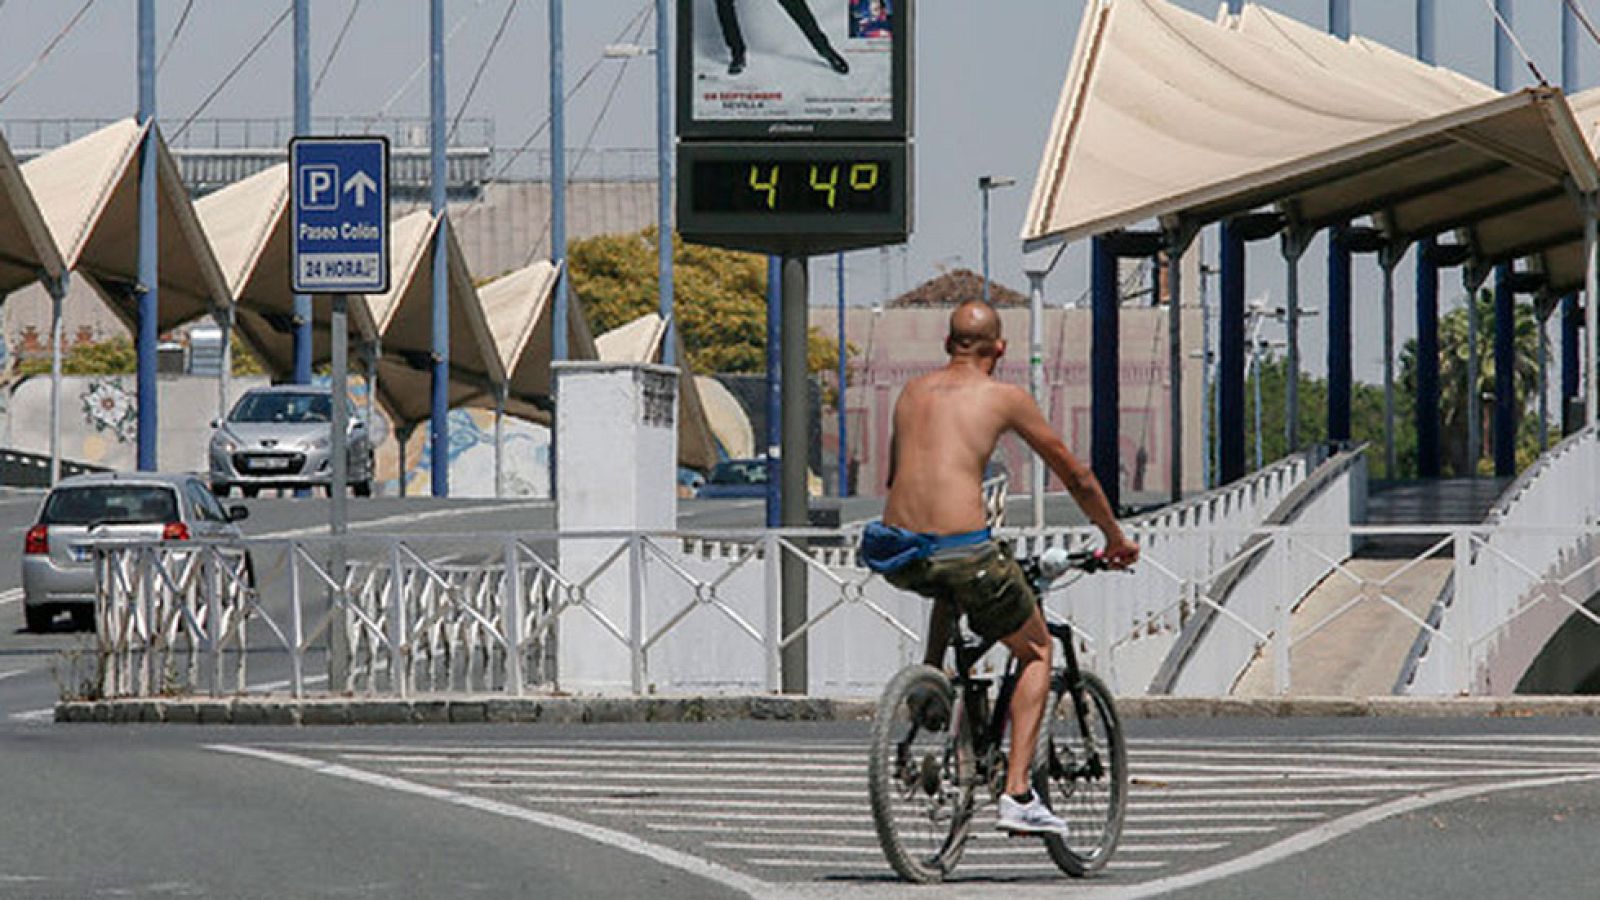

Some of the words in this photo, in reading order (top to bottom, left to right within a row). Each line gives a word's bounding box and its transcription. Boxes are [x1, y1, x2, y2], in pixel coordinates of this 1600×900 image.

[309, 171, 331, 203] P
[300, 223, 338, 240] Paseo
[341, 222, 378, 240] Colón
[306, 261, 321, 277] 24
